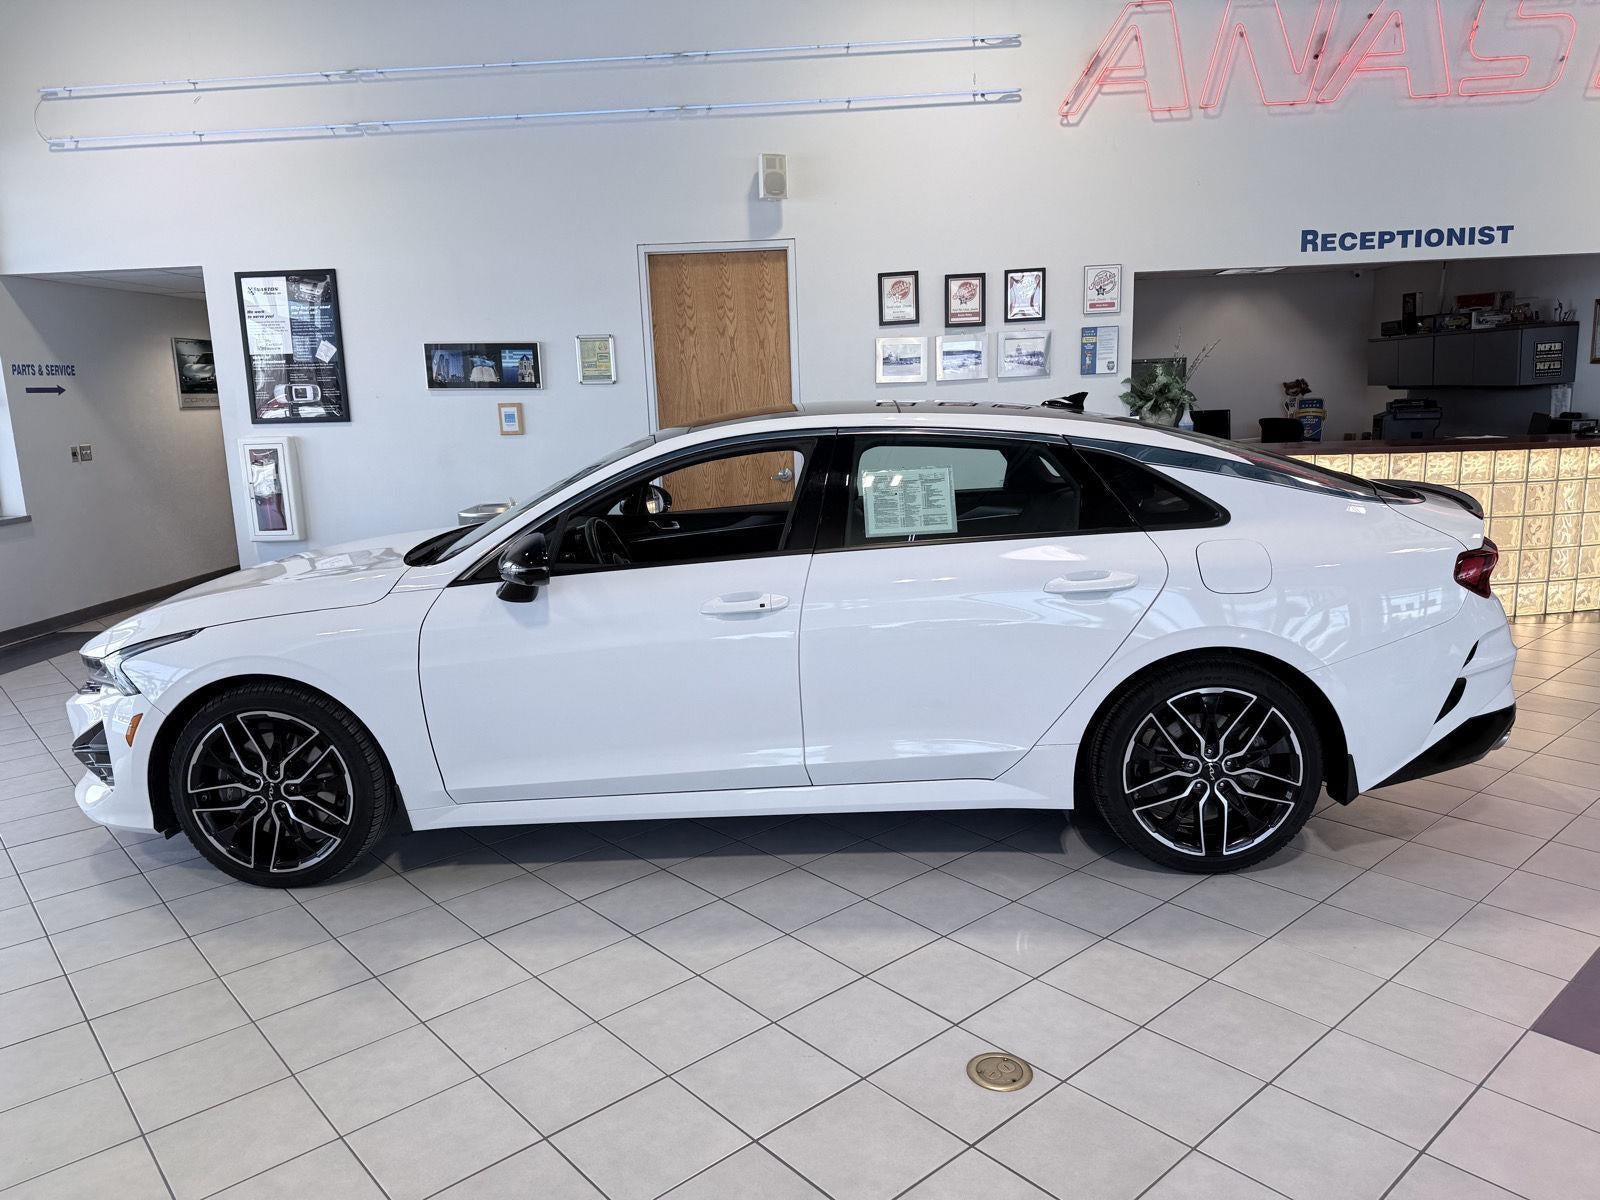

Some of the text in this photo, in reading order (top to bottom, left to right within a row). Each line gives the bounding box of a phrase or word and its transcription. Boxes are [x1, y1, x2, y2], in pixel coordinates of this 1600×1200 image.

[1058, 0, 1600, 116] ANAS
[1300, 225, 1515, 253] RECEPTIONIST
[12, 364, 76, 376] PARTS & SERVICE
